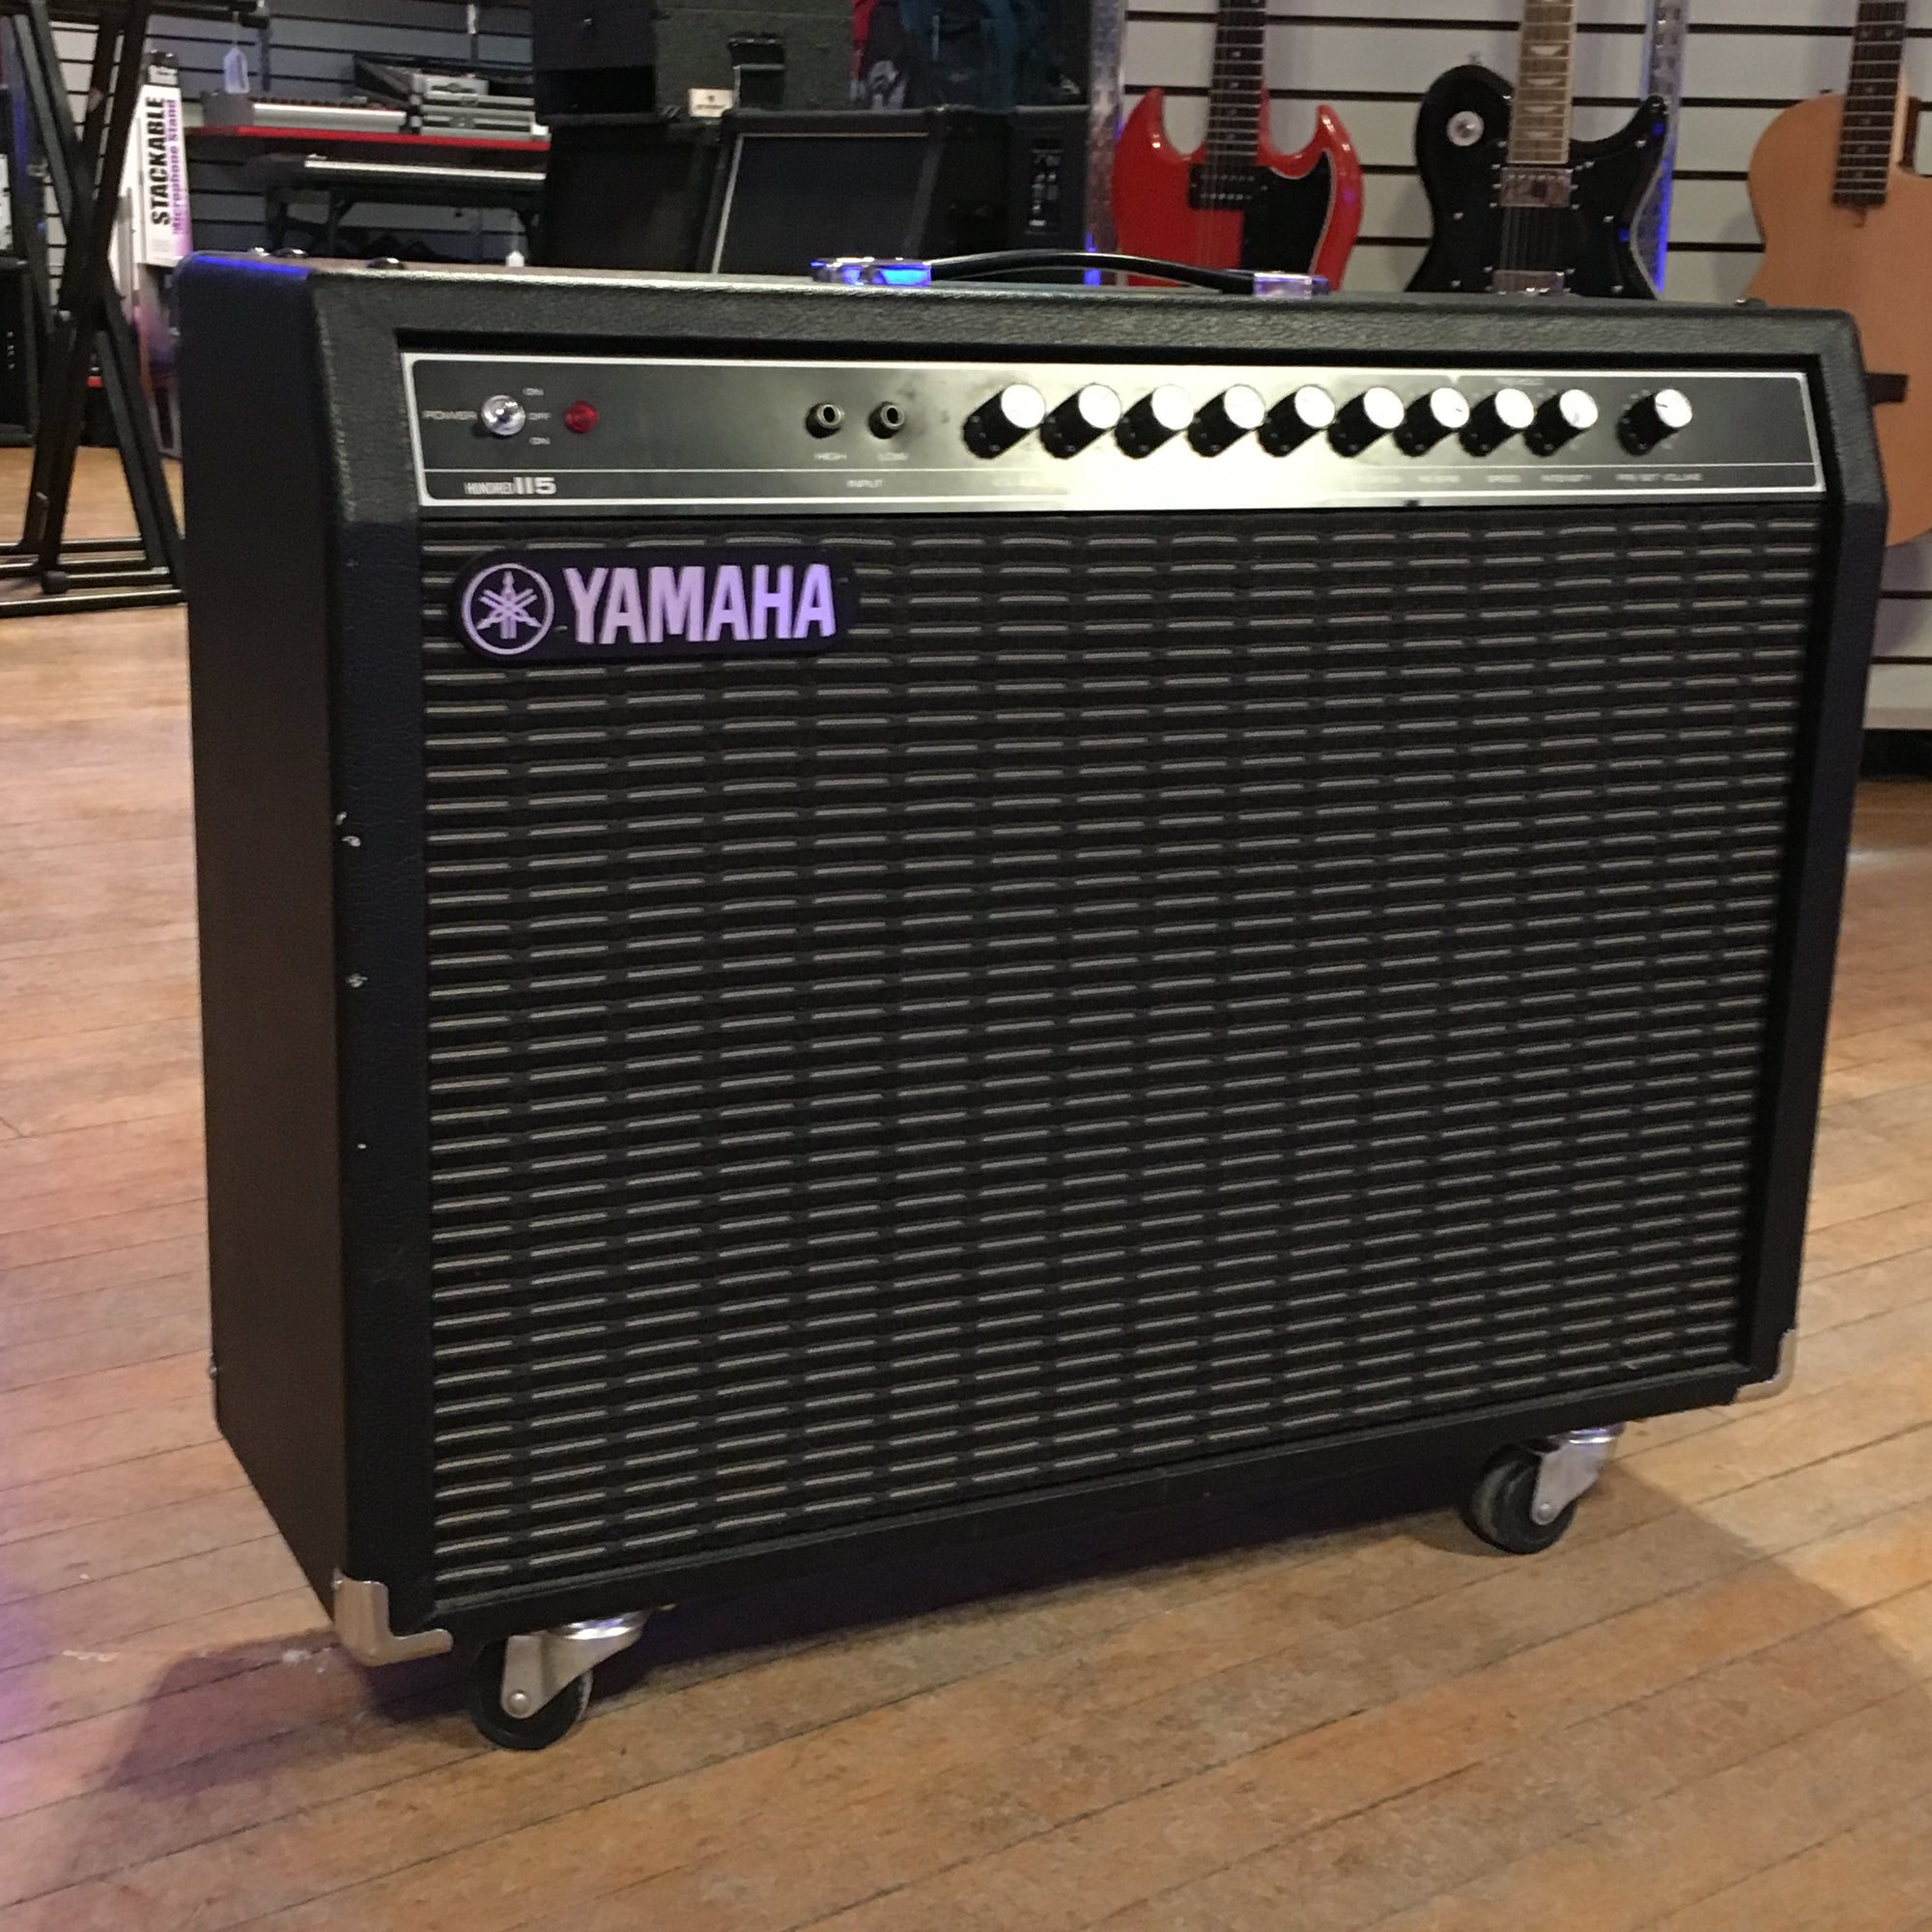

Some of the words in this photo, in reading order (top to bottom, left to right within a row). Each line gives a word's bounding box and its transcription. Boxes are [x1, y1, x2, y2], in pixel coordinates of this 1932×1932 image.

[166, 99, 179, 141] Stand
[146, 97, 170, 225] STACKABLE
[421, 411, 477, 420] POWER
[562, 563, 837, 644] YAMAHA
